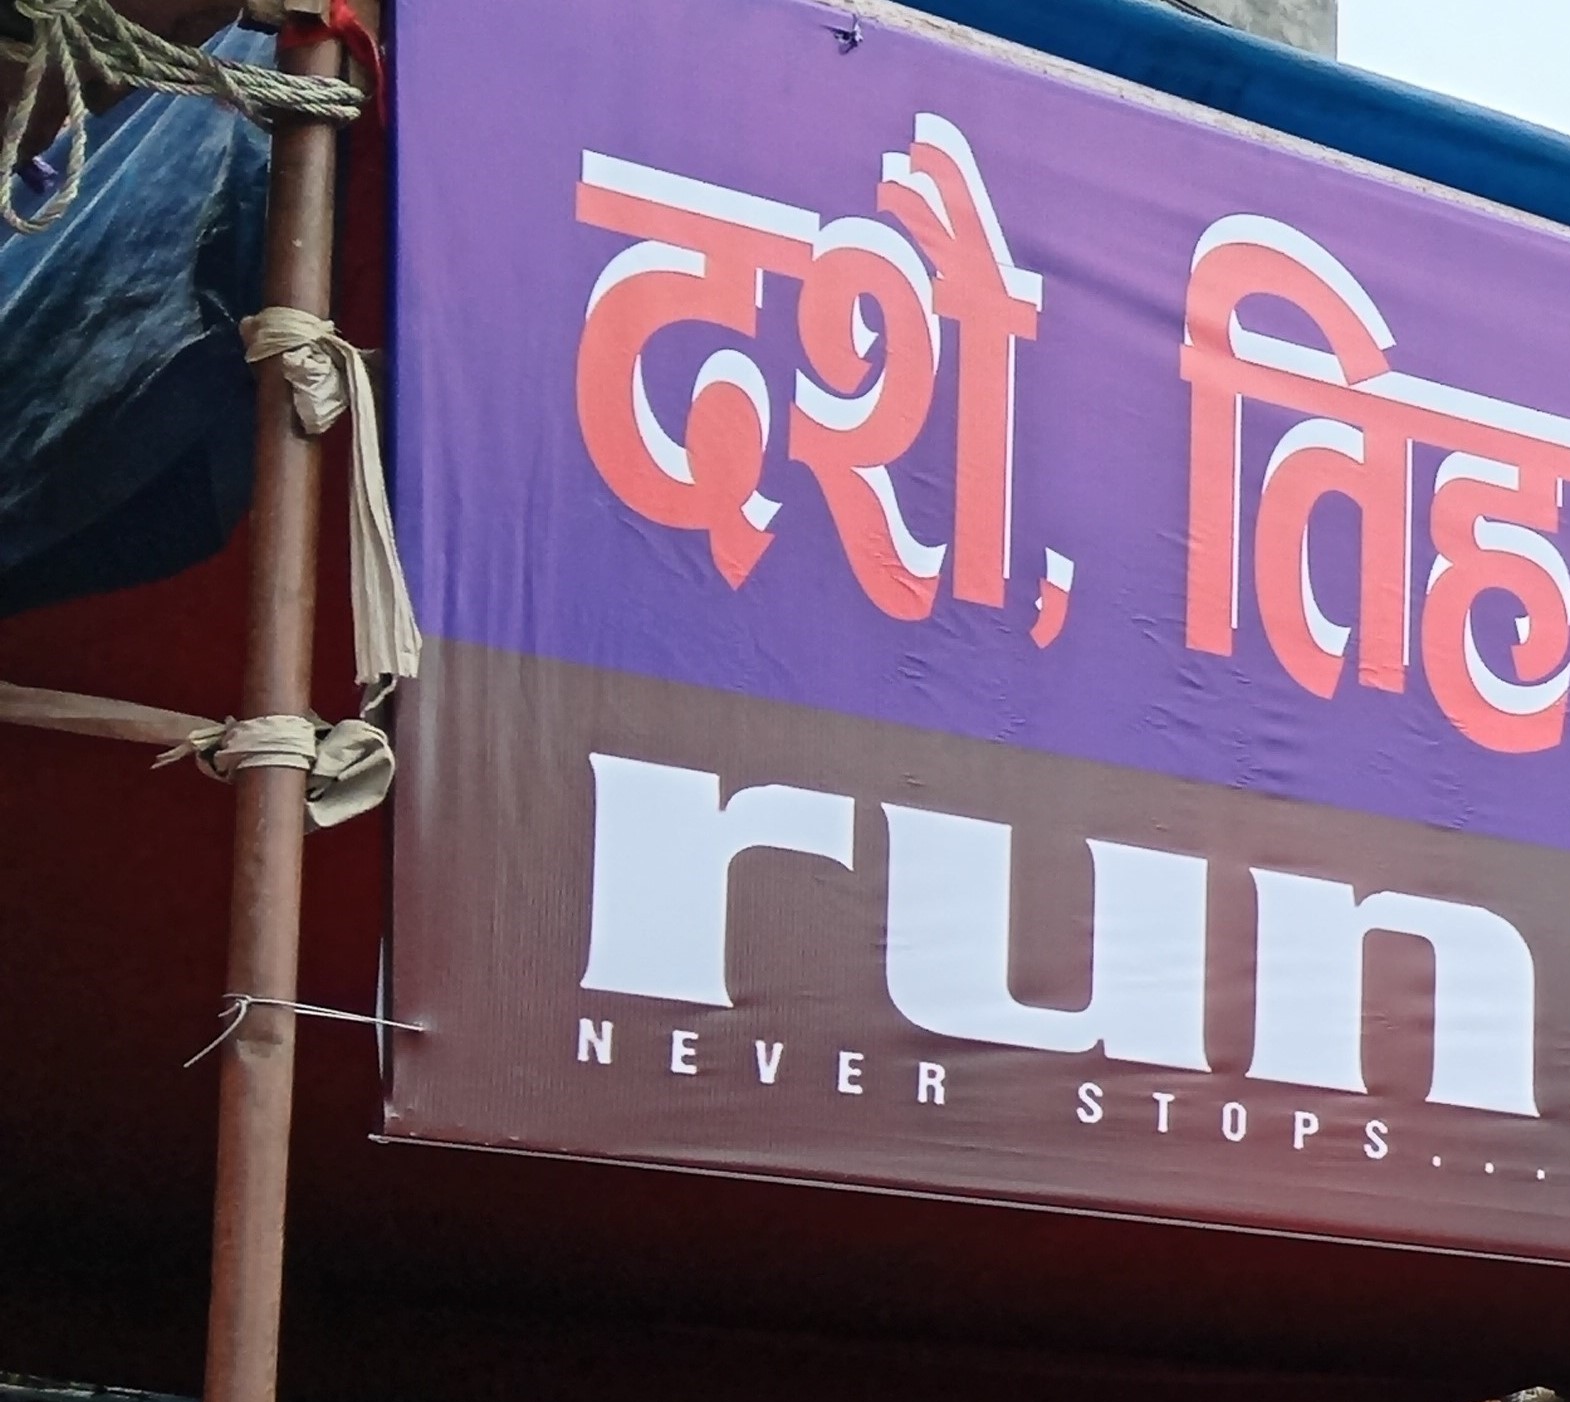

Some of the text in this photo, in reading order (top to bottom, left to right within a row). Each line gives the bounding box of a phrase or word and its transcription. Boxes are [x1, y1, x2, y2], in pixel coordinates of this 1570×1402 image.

[575, 112, 1074, 648] दशै,
[577, 1018, 1548, 1182] NEVER STOPS...
[580, 751, 1539, 1117] run
